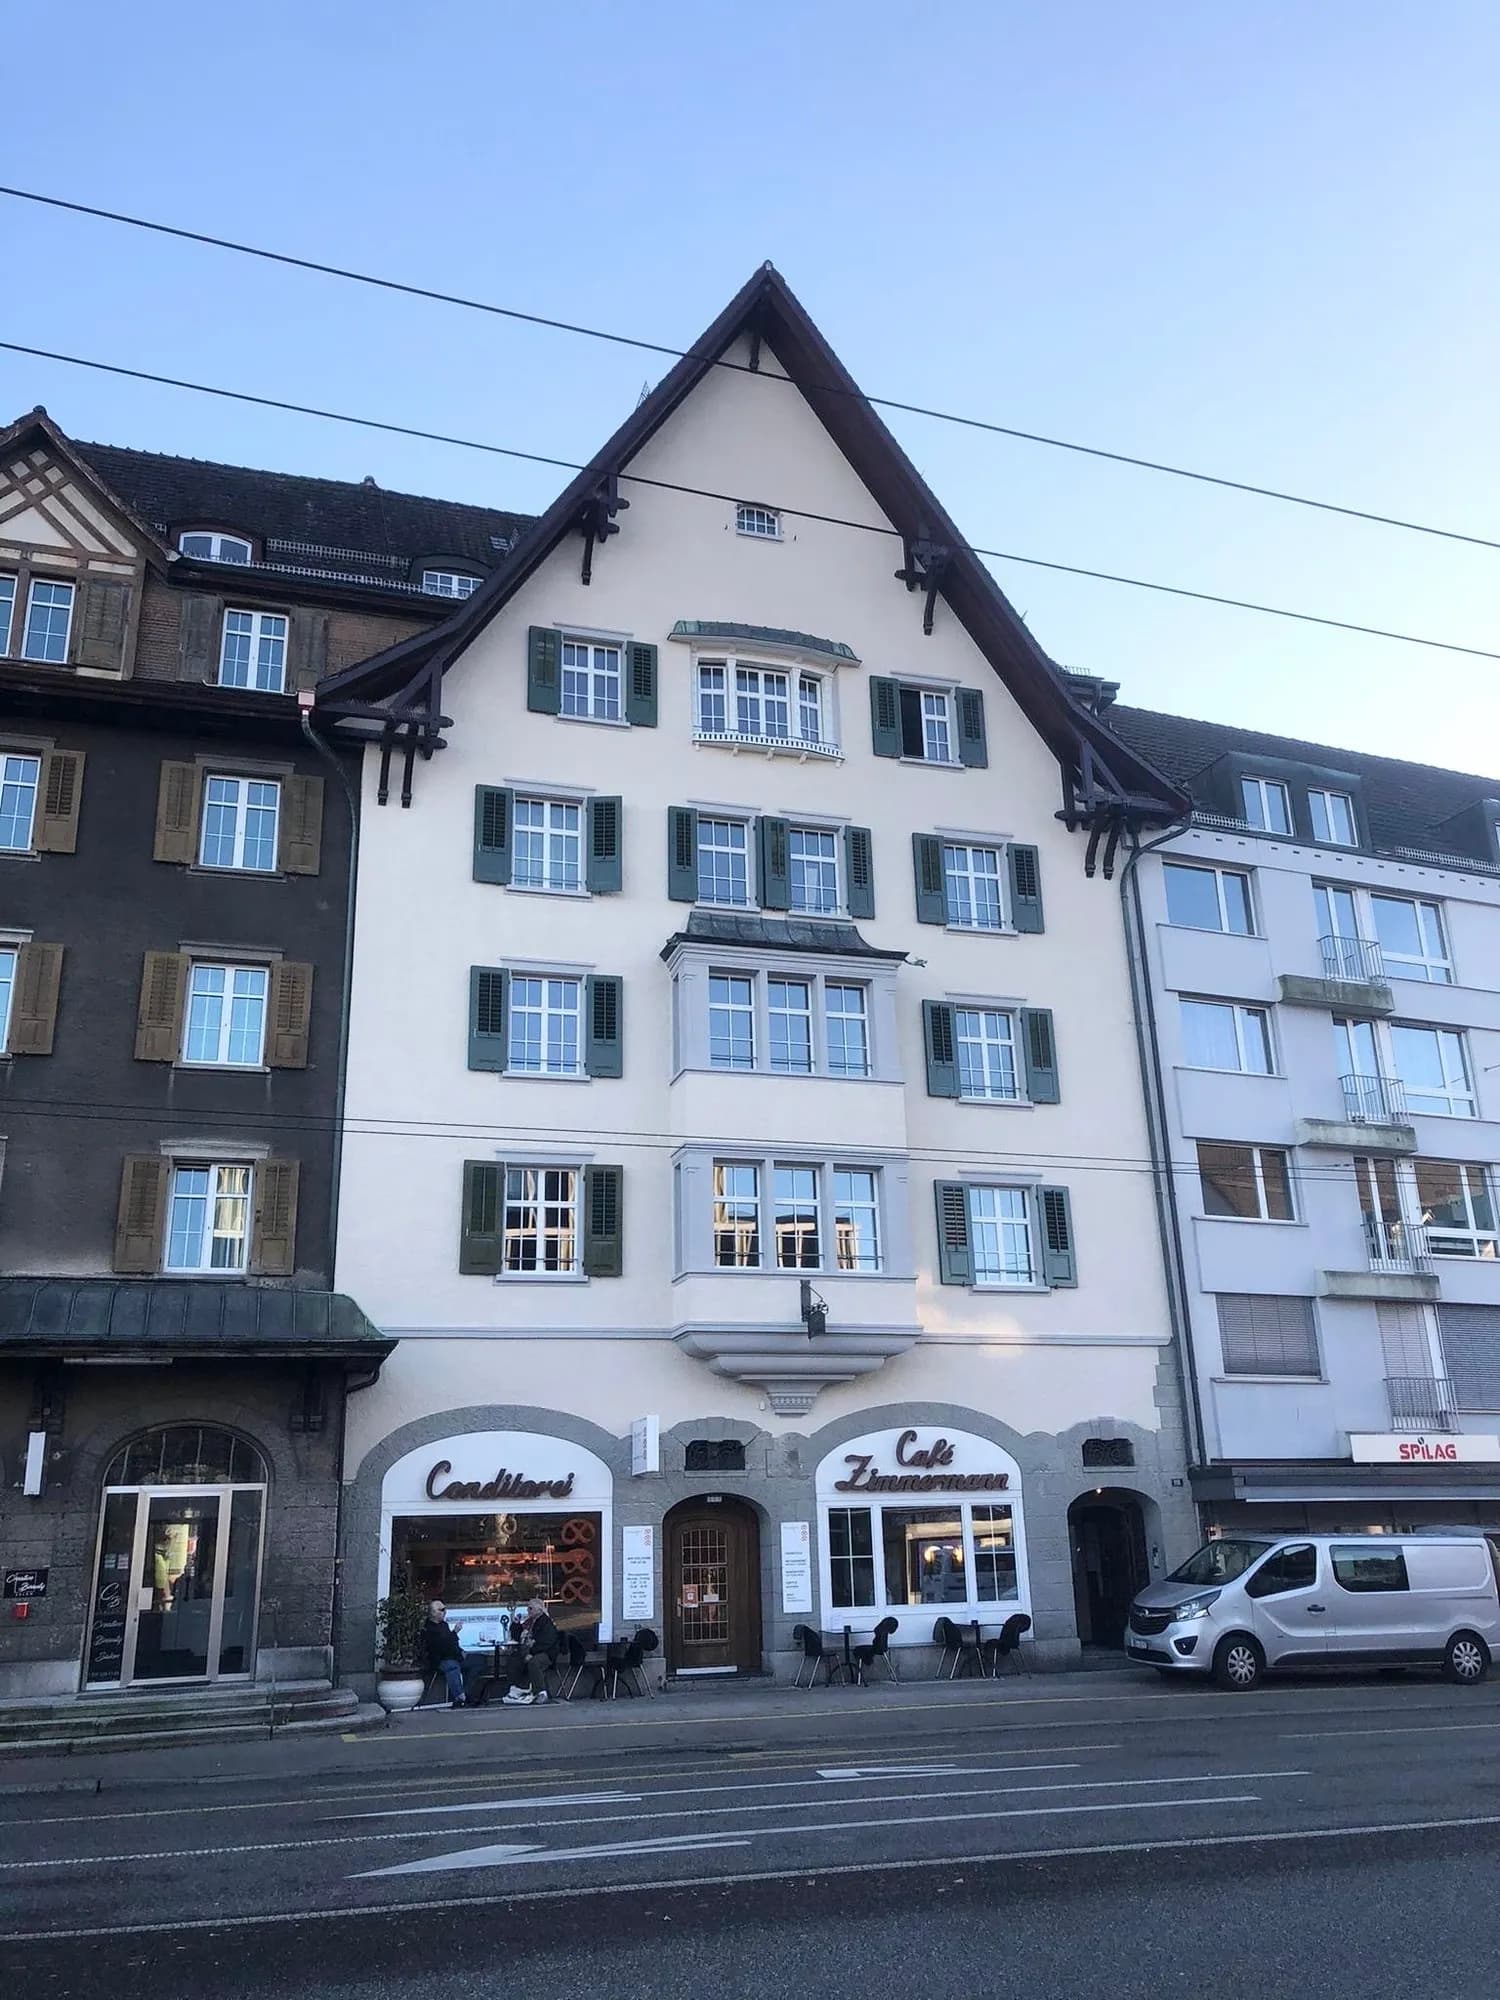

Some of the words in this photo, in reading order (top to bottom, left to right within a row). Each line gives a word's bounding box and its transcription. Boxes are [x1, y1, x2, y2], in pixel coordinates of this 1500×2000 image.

[896, 1429, 956, 1469] Café
[426, 1460, 575, 1500] Conditorei
[834, 1455, 1009, 1492] Zimmermann
